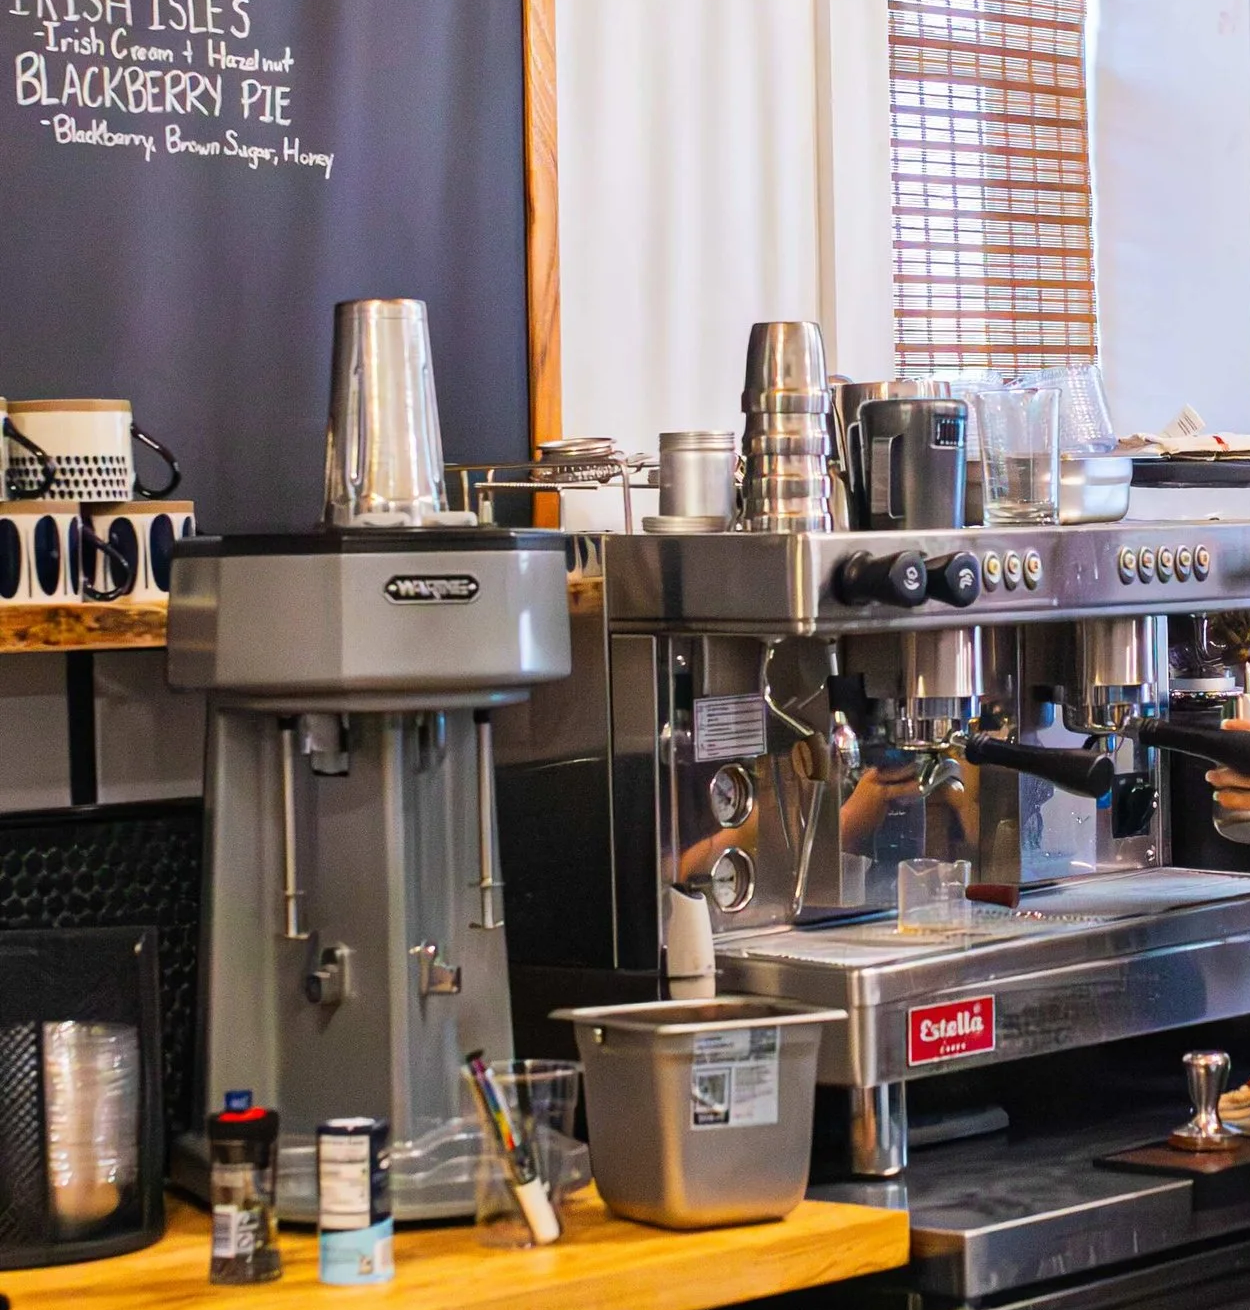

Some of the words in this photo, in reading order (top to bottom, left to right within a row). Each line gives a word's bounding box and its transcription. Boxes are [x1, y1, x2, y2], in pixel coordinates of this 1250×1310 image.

[110, 27, 174, 62] Cream
[207, 39, 295, 74] Hazelnut
[15, 50, 223, 117] BLACKBERRY
[240, 78, 292, 126] PIE
[164, 124, 221, 155] Brown
[282, 136, 336, 180] Honey
[920, 1010, 985, 1042] Estella
